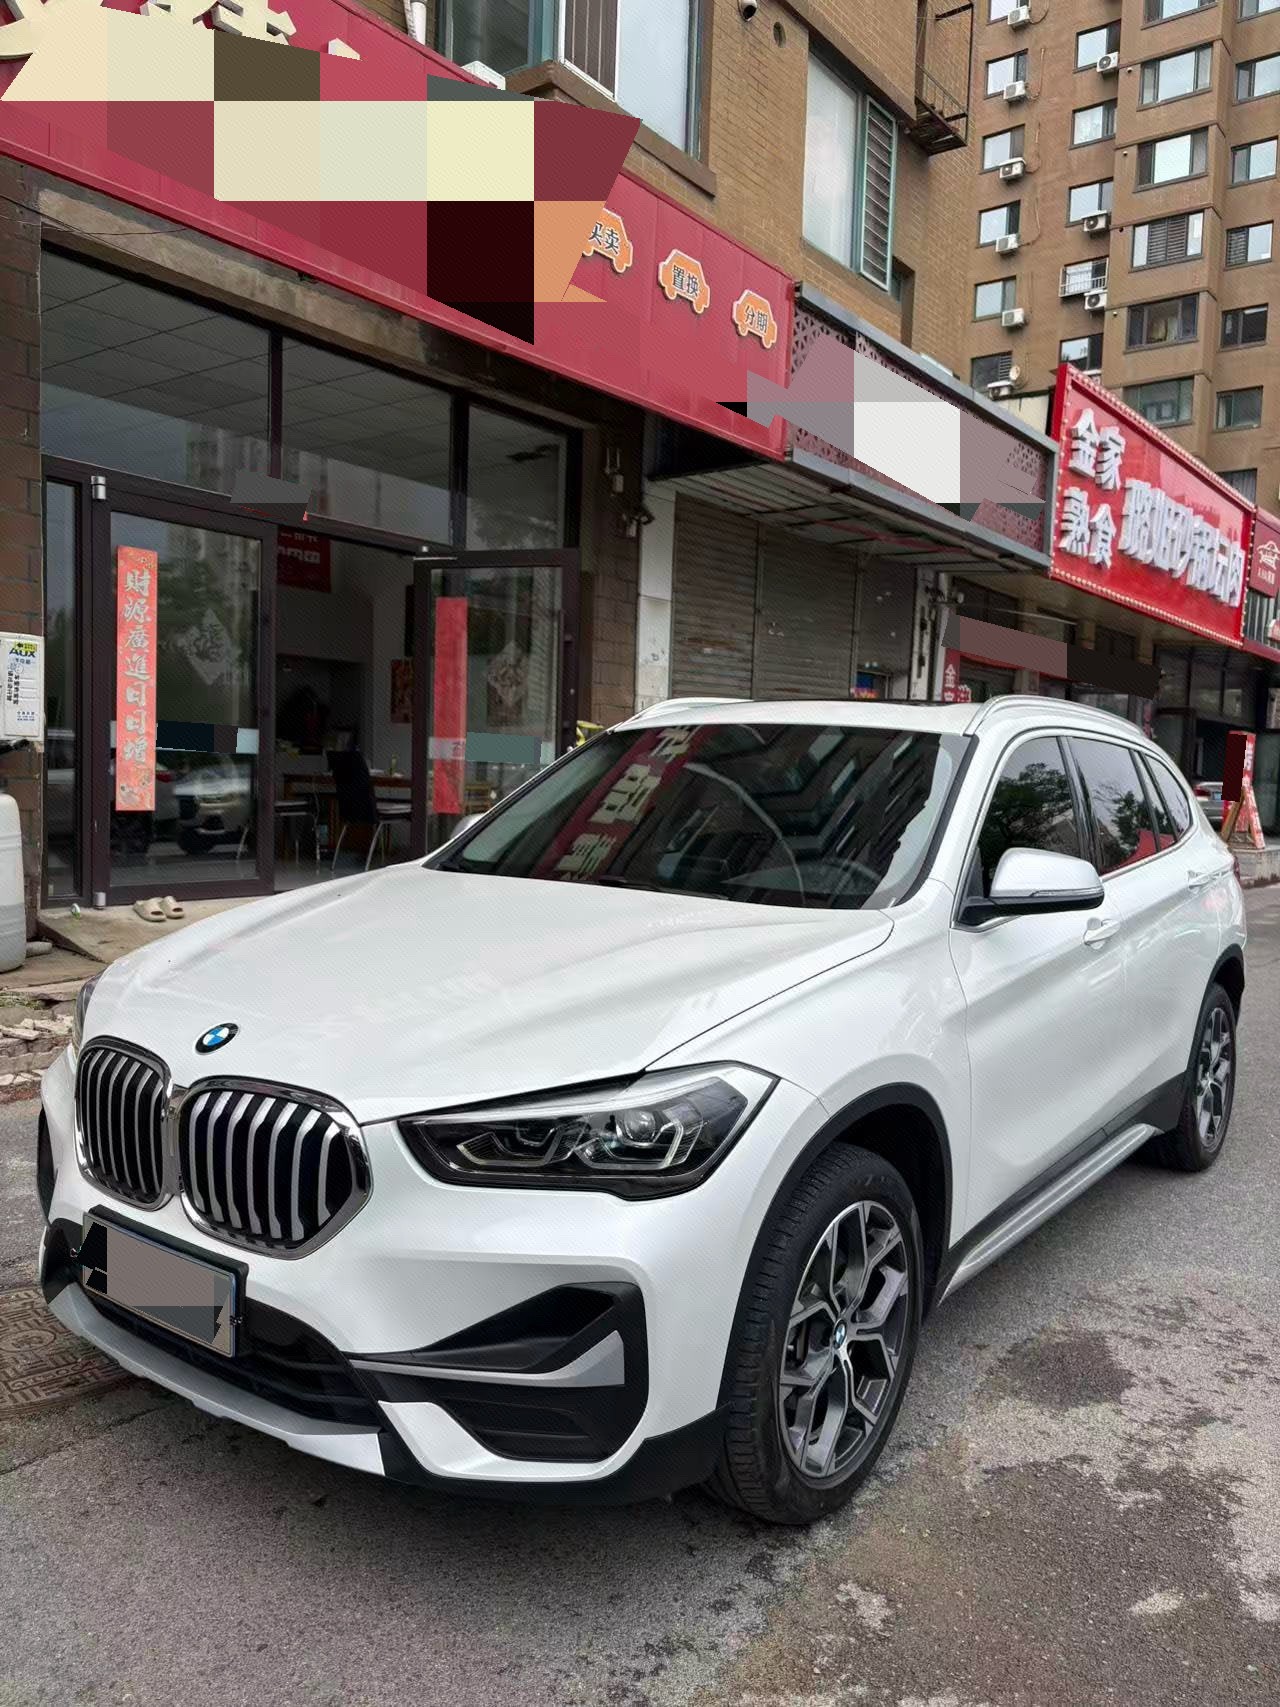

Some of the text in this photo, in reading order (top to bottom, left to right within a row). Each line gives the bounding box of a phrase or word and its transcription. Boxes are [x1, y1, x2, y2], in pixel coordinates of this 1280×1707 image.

[671, 264, 700, 297] 置换
[744, 305, 769, 333] 分期
[1068, 408, 1126, 491] 金家
[1058, 486, 1116, 569] 熟食
[9, 647, 36, 658] AUX
